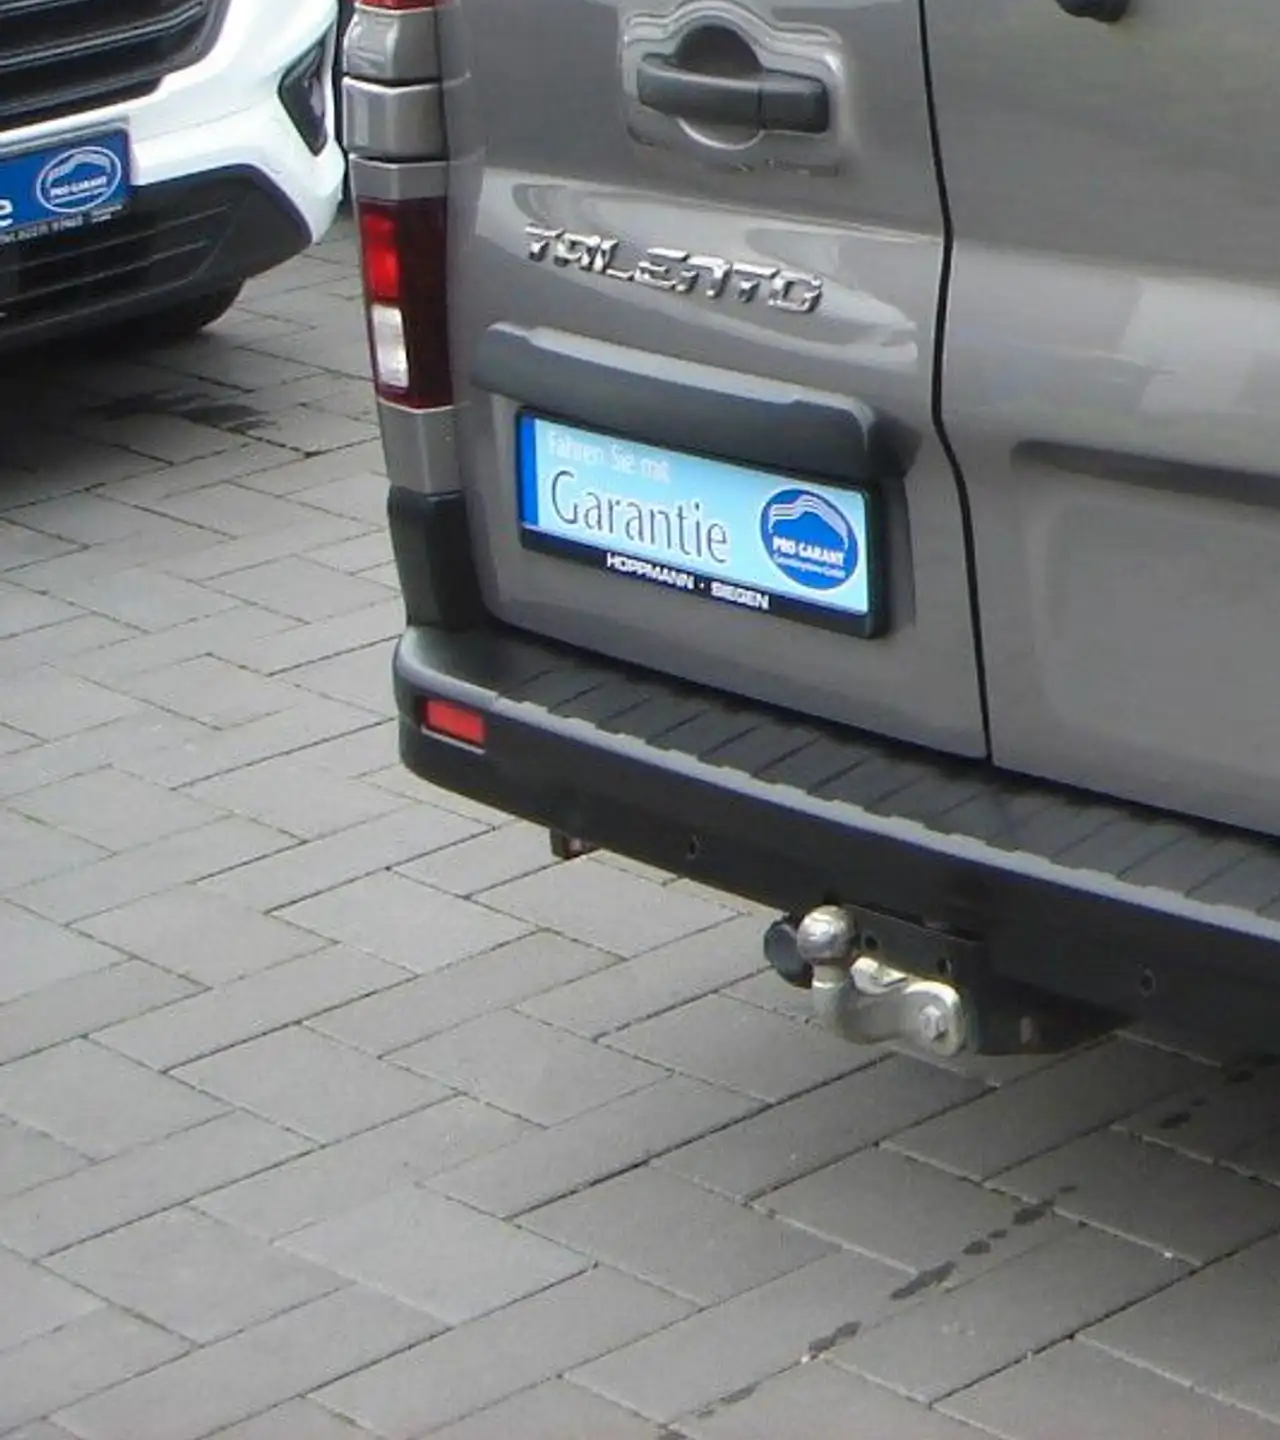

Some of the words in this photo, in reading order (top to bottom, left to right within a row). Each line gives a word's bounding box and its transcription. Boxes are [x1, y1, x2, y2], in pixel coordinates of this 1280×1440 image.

[549, 430, 604, 464] Fahren
[610, 443, 636, 475] Sie
[551, 469, 728, 563] Garantie
[772, 534, 796, 555] PRO
[798, 541, 845, 567] GARANT
[606, 552, 695, 590] HOPPMANN
[711, 580, 770, 611] SIEGEN
